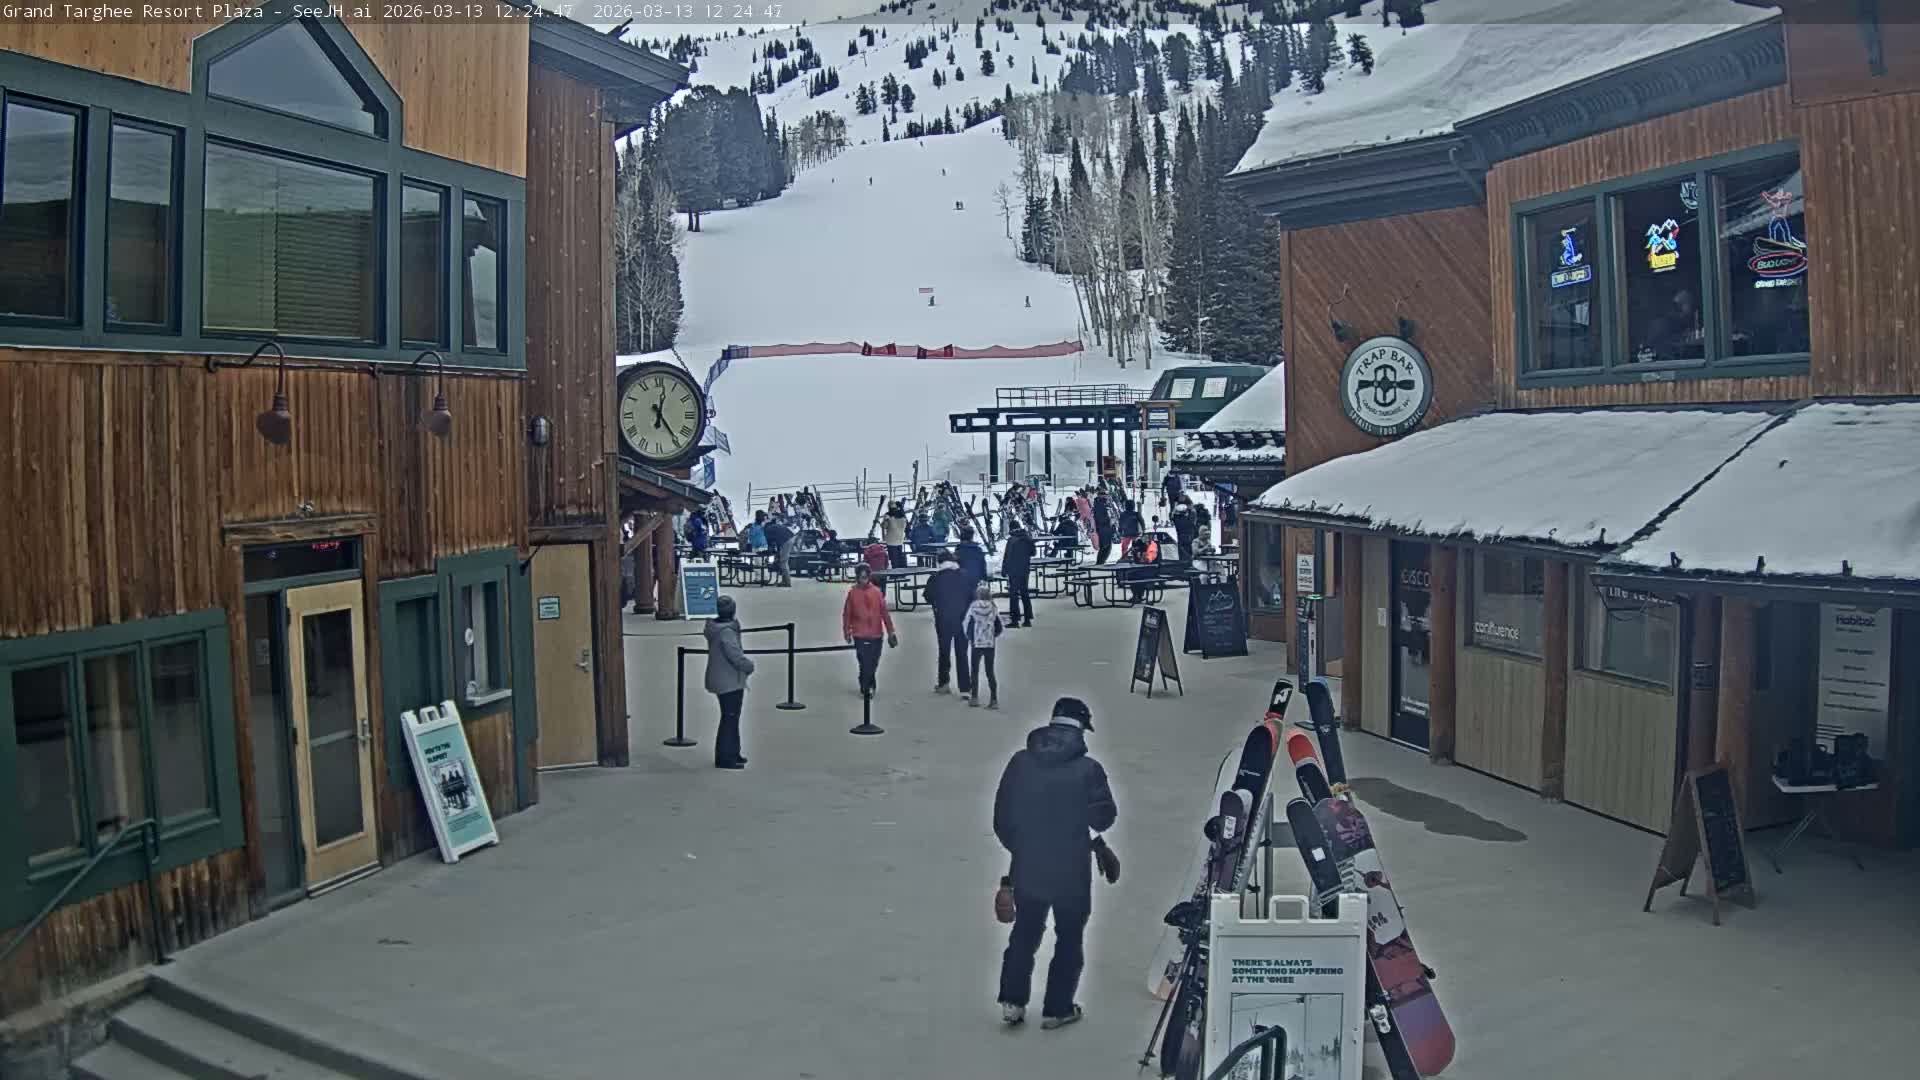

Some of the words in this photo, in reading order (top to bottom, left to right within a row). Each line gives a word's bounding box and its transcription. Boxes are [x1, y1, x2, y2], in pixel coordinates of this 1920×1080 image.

[1356, 348, 1386, 376] TRAP
[1391, 350, 1414, 375] BAR
[1474, 621, 1520, 640] confluence
[1232, 967, 1288, 975] SOMETHING
[1289, 967, 1344, 975] HAPPENING
[1232, 976, 1245, 984] AT
[1246, 976, 1265, 984] THE
